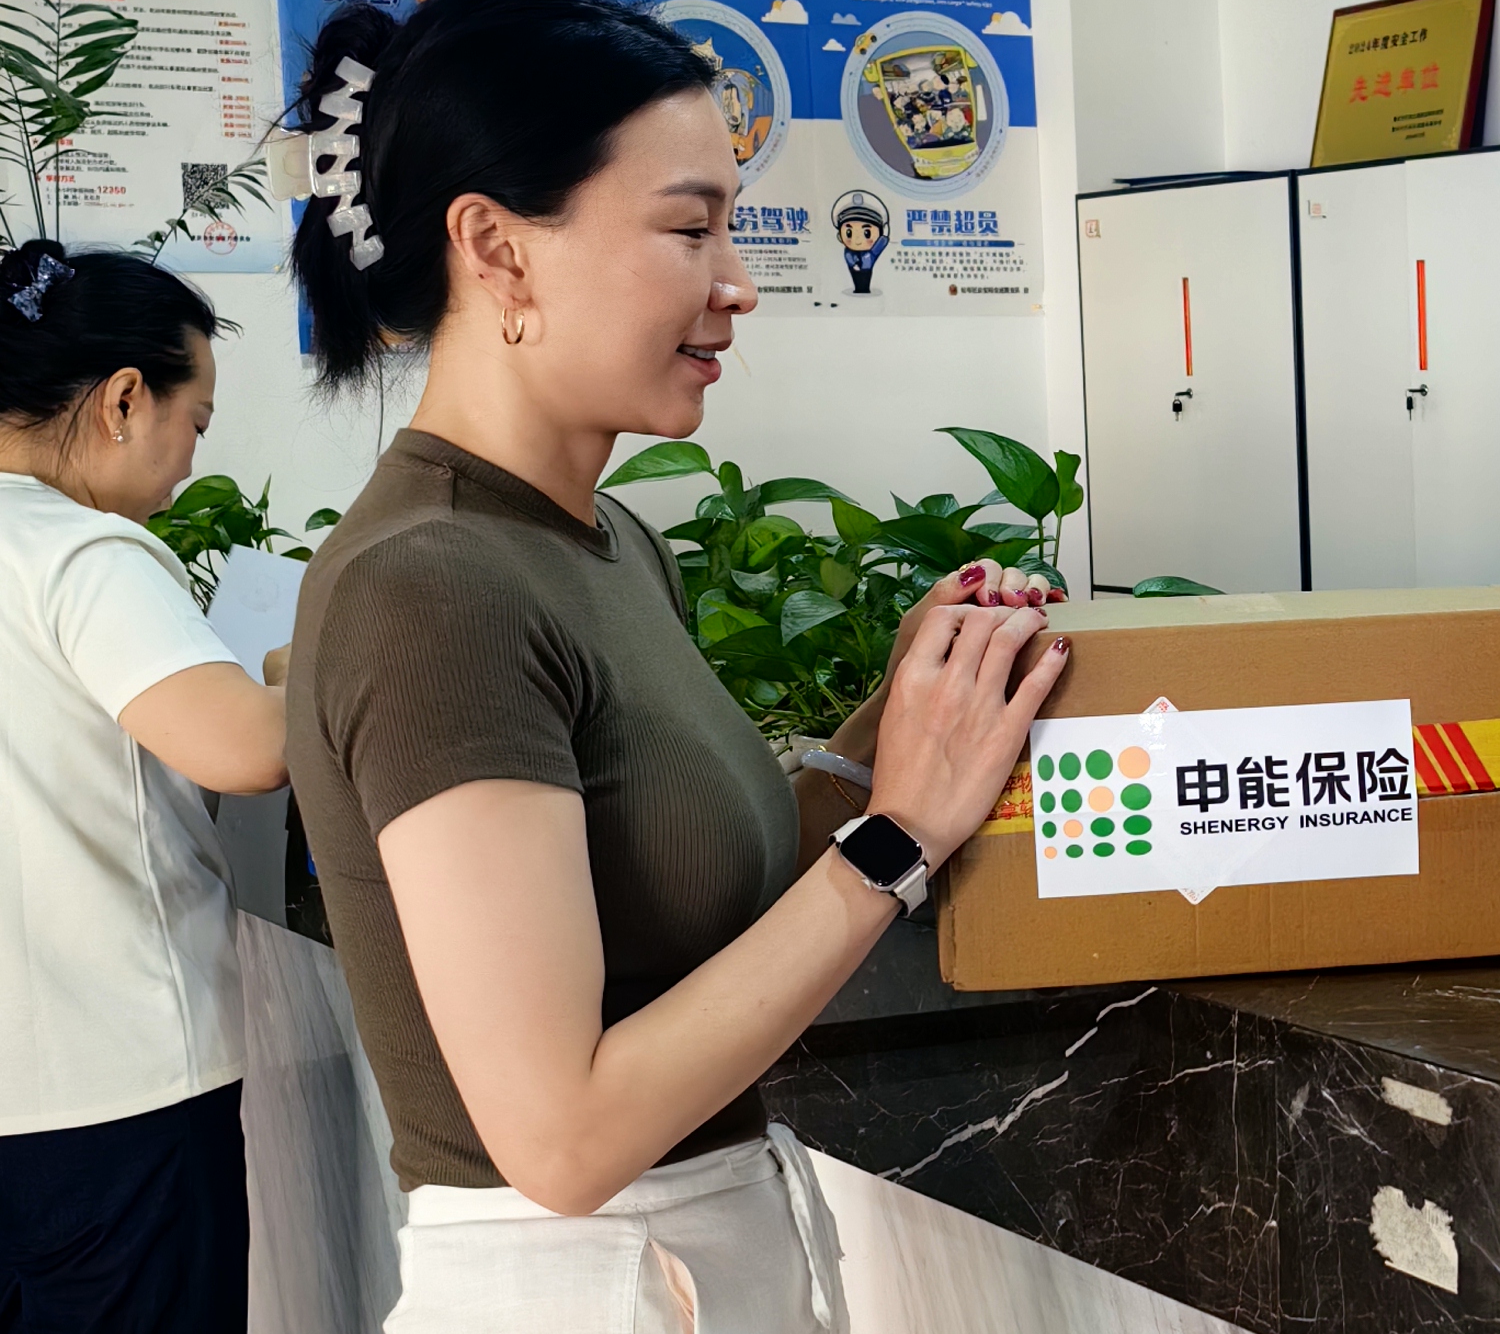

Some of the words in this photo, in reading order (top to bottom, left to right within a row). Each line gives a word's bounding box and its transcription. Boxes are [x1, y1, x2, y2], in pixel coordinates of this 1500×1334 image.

[97, 186, 126, 195] 12350
[906, 209, 999, 236] 严禁超员
[1176, 748, 1412, 813] 申能保险
[1180, 816, 1289, 835] SHENERGY
[1300, 807, 1413, 829] INSURANCE
